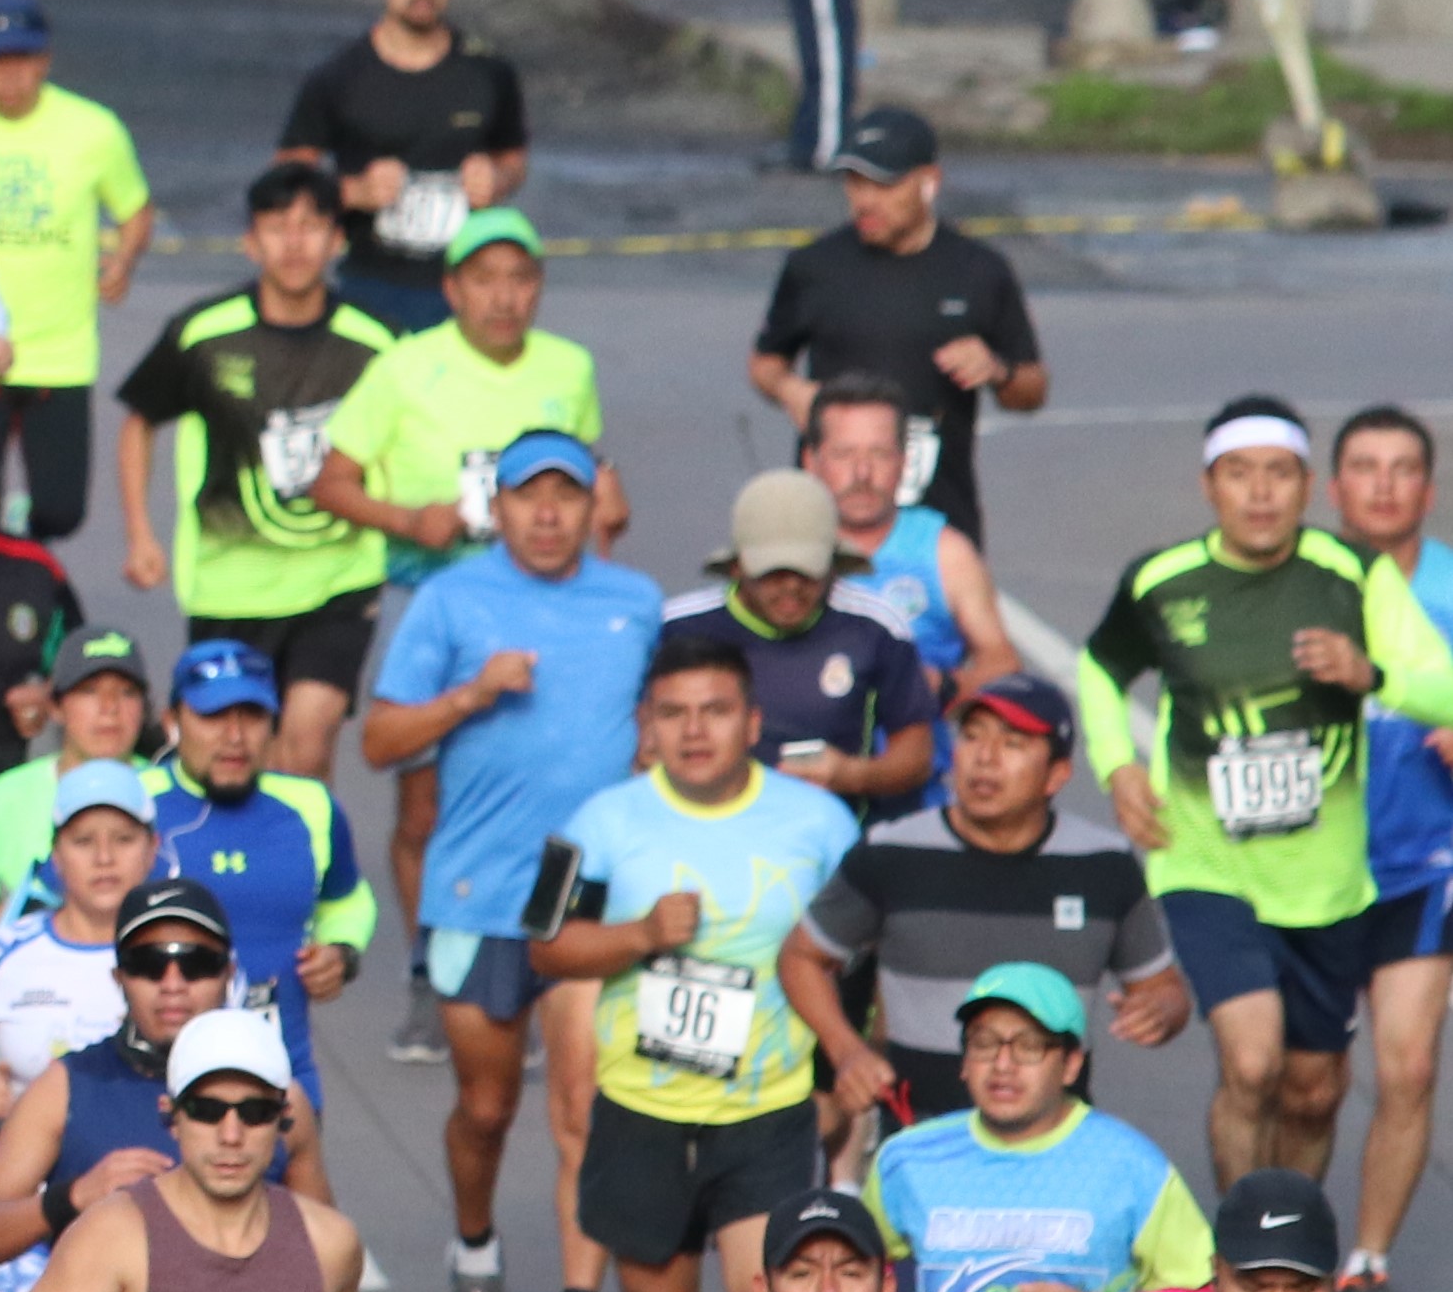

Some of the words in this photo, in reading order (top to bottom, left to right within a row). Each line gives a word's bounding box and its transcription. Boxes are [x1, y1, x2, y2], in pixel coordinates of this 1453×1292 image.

[1219, 759, 1317, 807] 1995
[668, 989, 717, 1044] 96
[926, 1210, 1094, 1255] RUNNER
